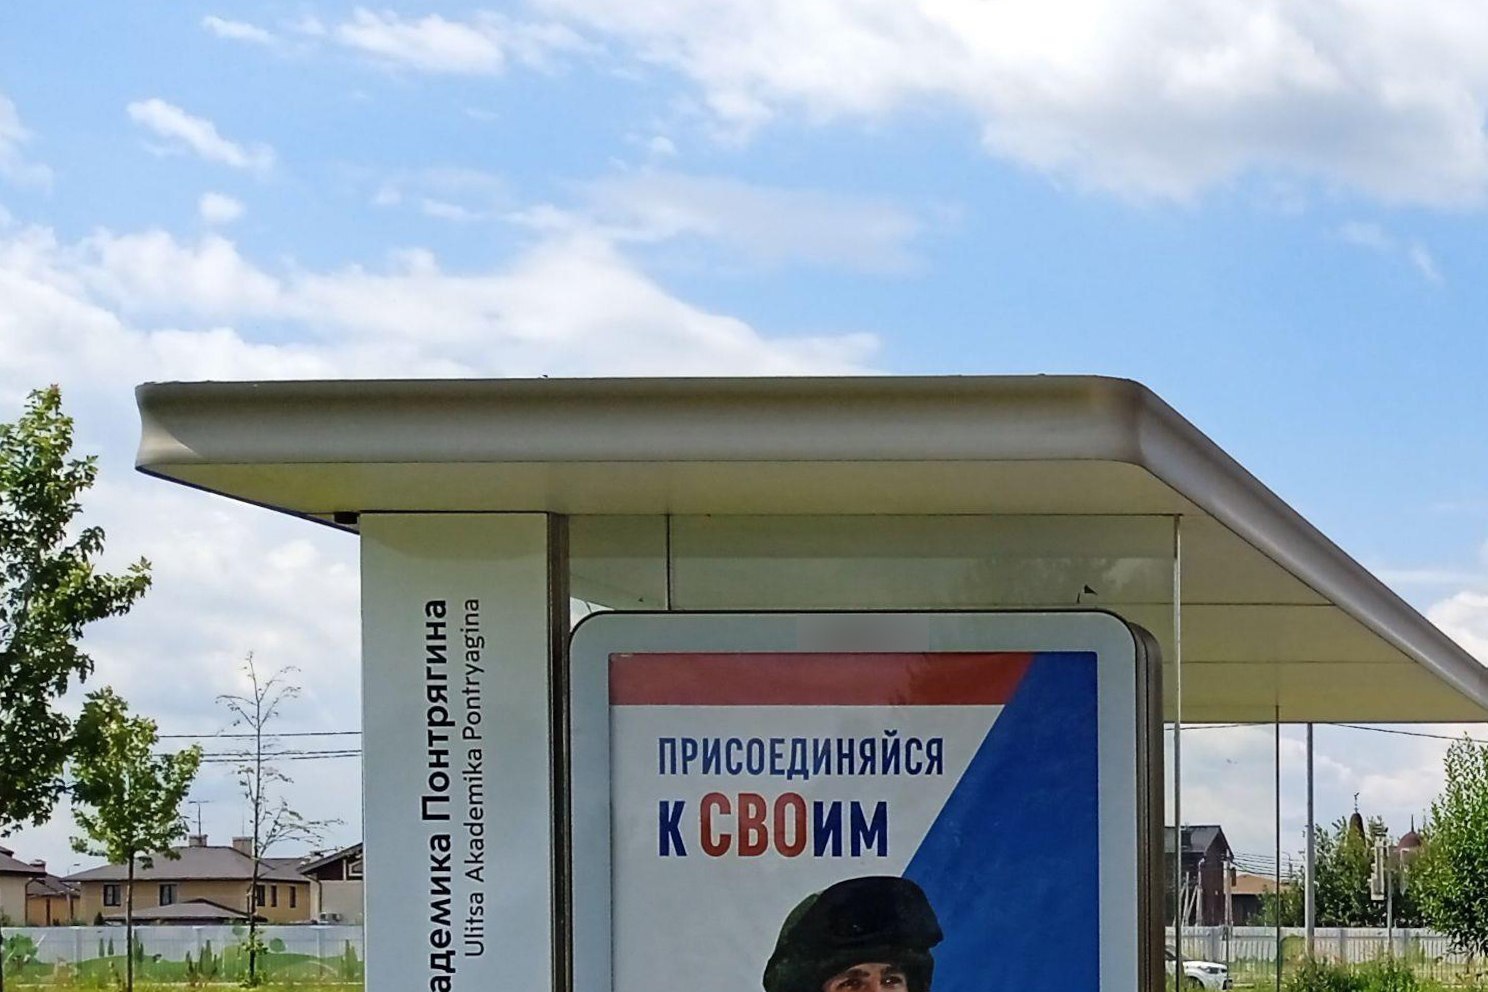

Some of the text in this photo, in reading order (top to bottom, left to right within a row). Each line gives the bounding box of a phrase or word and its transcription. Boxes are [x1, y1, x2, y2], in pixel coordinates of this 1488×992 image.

[421, 599, 455, 822] Понтрягина
[460, 598, 486, 957] Ulitsa Akademika Pontryagina
[658, 729, 944, 780] ПРИСОЕДИНЯЙСЯ
[658, 791, 888, 857] К СВОИМ
